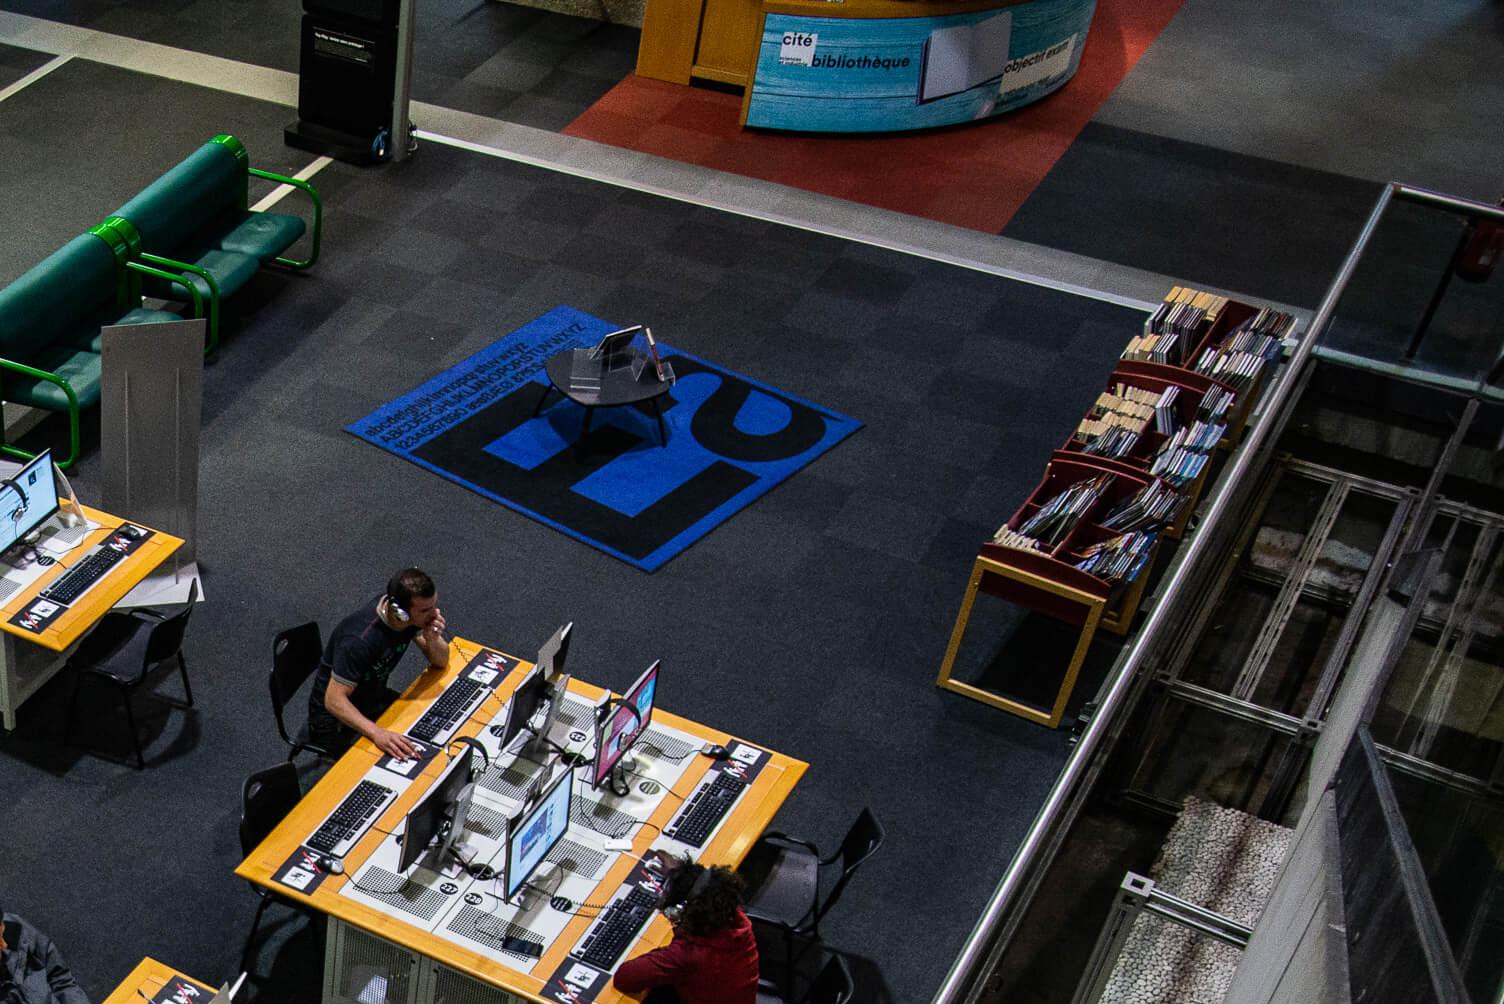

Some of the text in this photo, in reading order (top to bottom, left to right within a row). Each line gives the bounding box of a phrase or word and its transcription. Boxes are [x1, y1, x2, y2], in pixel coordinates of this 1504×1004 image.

[783, 32, 813, 47] cité
[811, 54, 910, 71] bibliothèque
[1004, 49, 1046, 73] objectif
